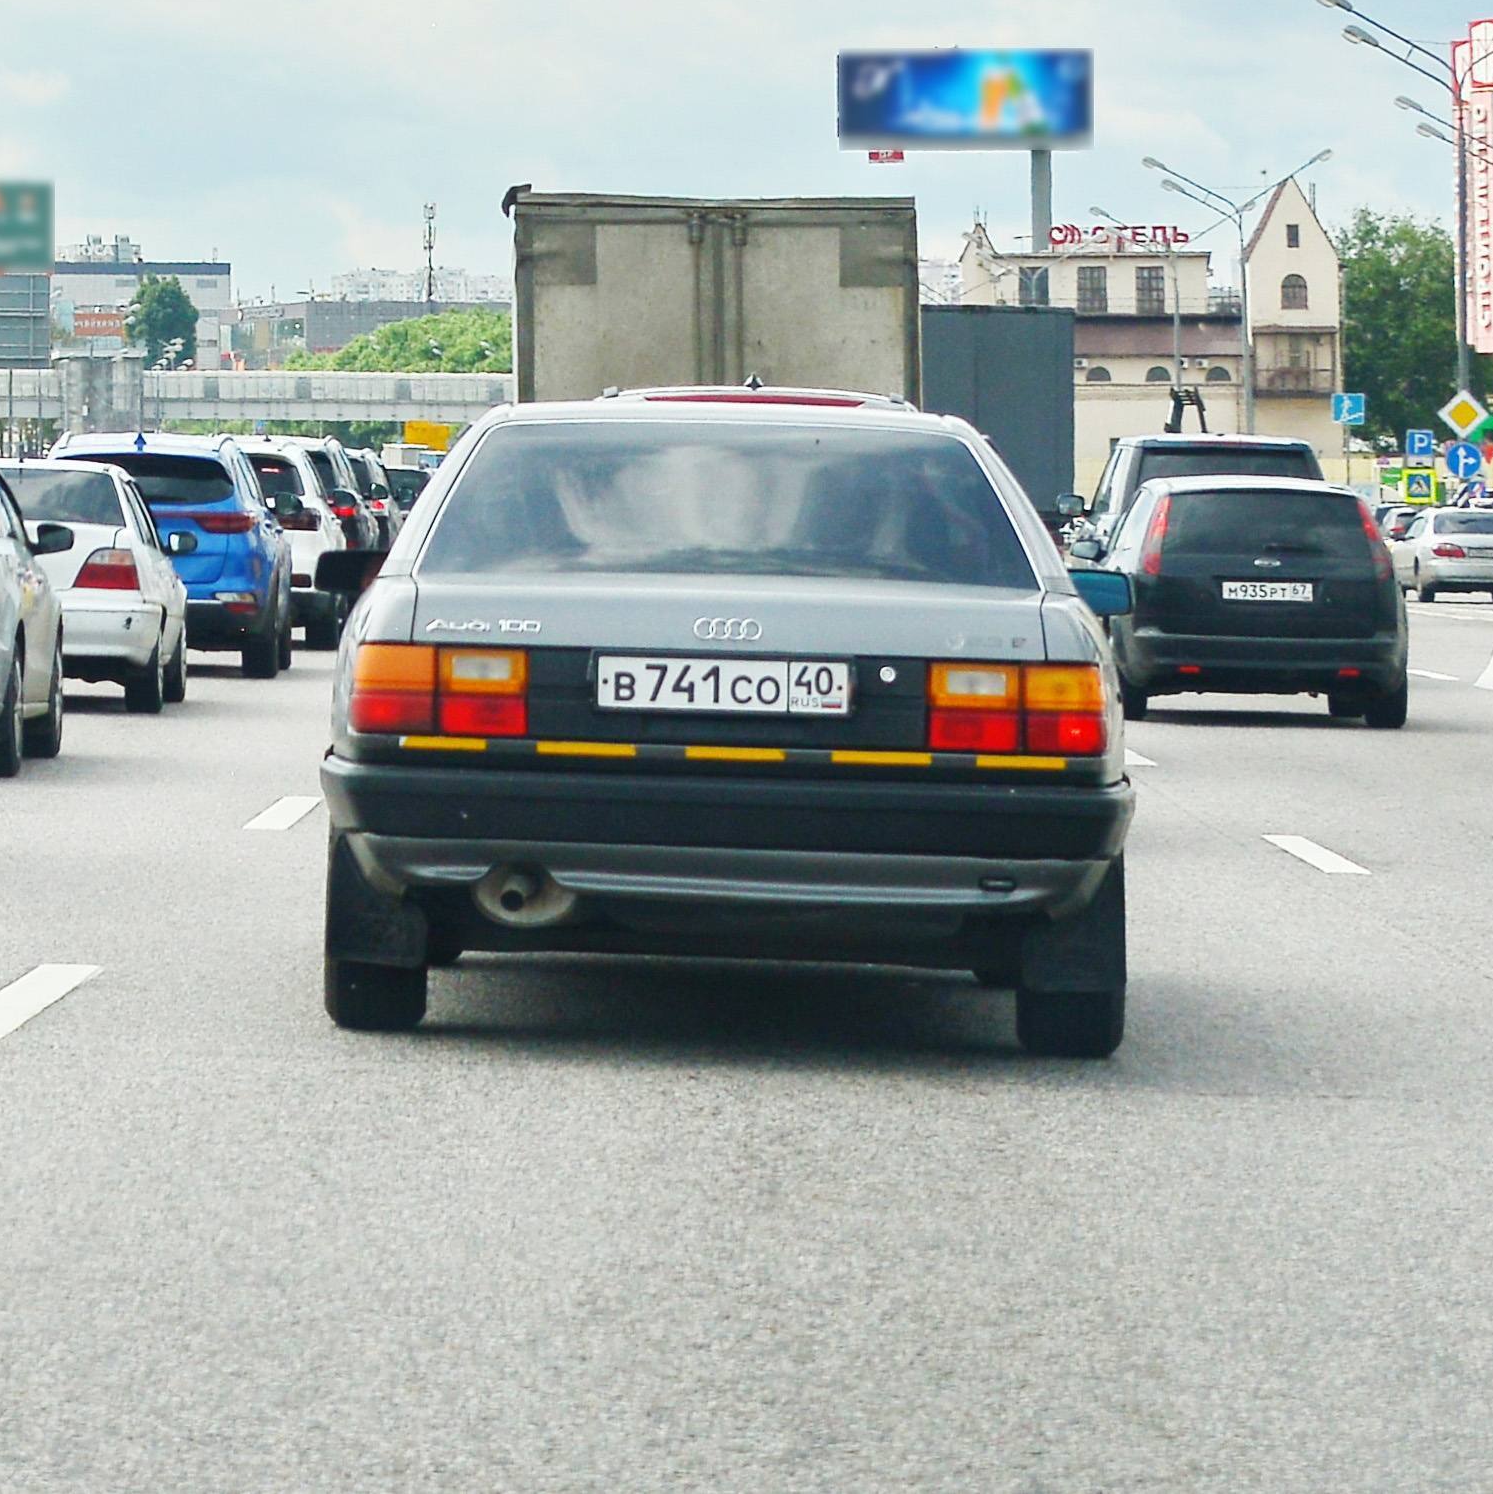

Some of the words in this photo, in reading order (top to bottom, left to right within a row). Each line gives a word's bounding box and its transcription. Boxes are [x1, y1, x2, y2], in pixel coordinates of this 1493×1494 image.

[1414, 433, 1428, 453] P
[426, 618, 491, 633] Audi
[498, 619, 542, 633] 100
[614, 664, 781, 704] В741СО
[794, 665, 833, 695] 40
[791, 697, 819, 707] RUS
